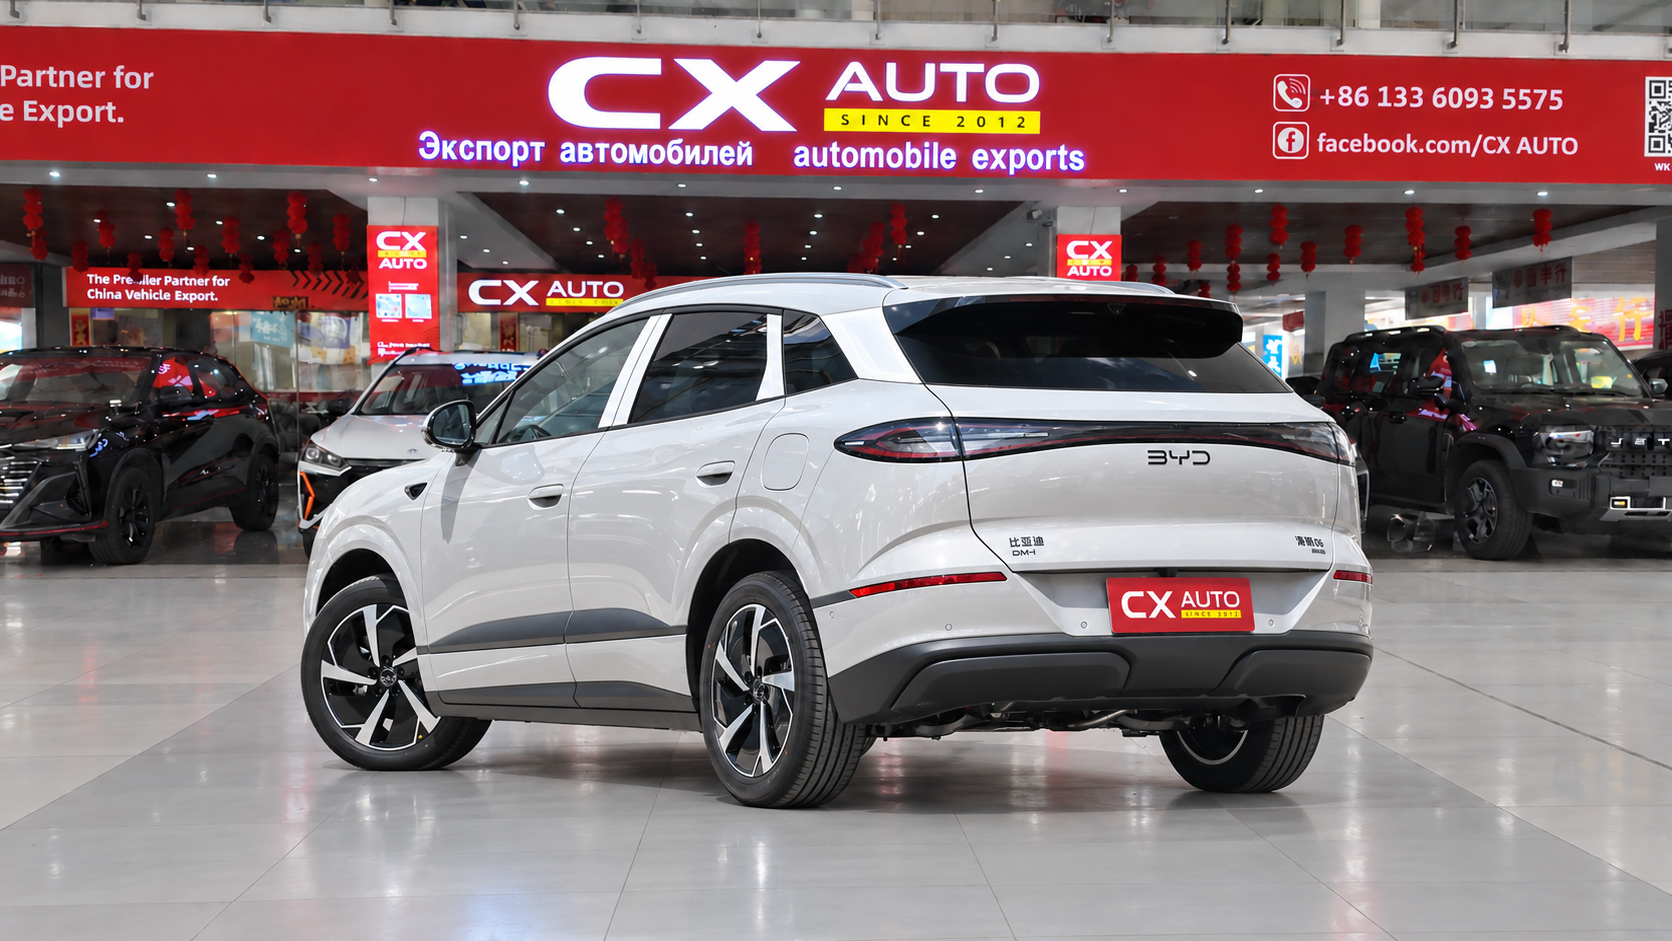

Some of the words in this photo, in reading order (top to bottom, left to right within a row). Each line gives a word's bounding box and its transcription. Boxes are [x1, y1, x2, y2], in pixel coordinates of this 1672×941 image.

[1, 65, 105, 88] Partner
[114, 66, 153, 88] for
[549, 57, 800, 131] CX
[826, 62, 1039, 102] AUTO
[1320, 86, 1368, 106] +86
[1378, 86, 1423, 107] 133
[1433, 87, 1493, 108] 6093
[1503, 89, 1562, 110] 5575
[24, 101, 123, 128] Export.
[841, 114, 930, 127] SINCE
[957, 116, 1025, 128] 2012
[419, 131, 545, 166] Экспорт
[560, 139, 752, 165] автомобилей
[1317, 133, 1510, 157] facebook.com/CX
[1516, 137, 1578, 154] AUTO
[794, 142, 956, 169] automobile
[972, 144, 1084, 175] exports
[377, 231, 426, 250] CX
[1067, 241, 1112, 258] CX
[379, 258, 427, 269] AUTO
[1067, 266, 1112, 276] AUTO
[86, 273, 111, 285] The
[164, 275, 211, 287] Partner
[211, 275, 231, 287] for
[86, 287, 123, 300] China
[124, 288, 171, 301] Vehicle
[174, 290, 219, 304] Export.
[469, 280, 538, 305] CX
[547, 281, 623, 297] AUTO
[1148, 450, 1210, 465] BYD
[1010, 537, 1044, 547] 比亚迪
[1122, 591, 1176, 618] CX
[1182, 591, 1239, 607] AUTO
